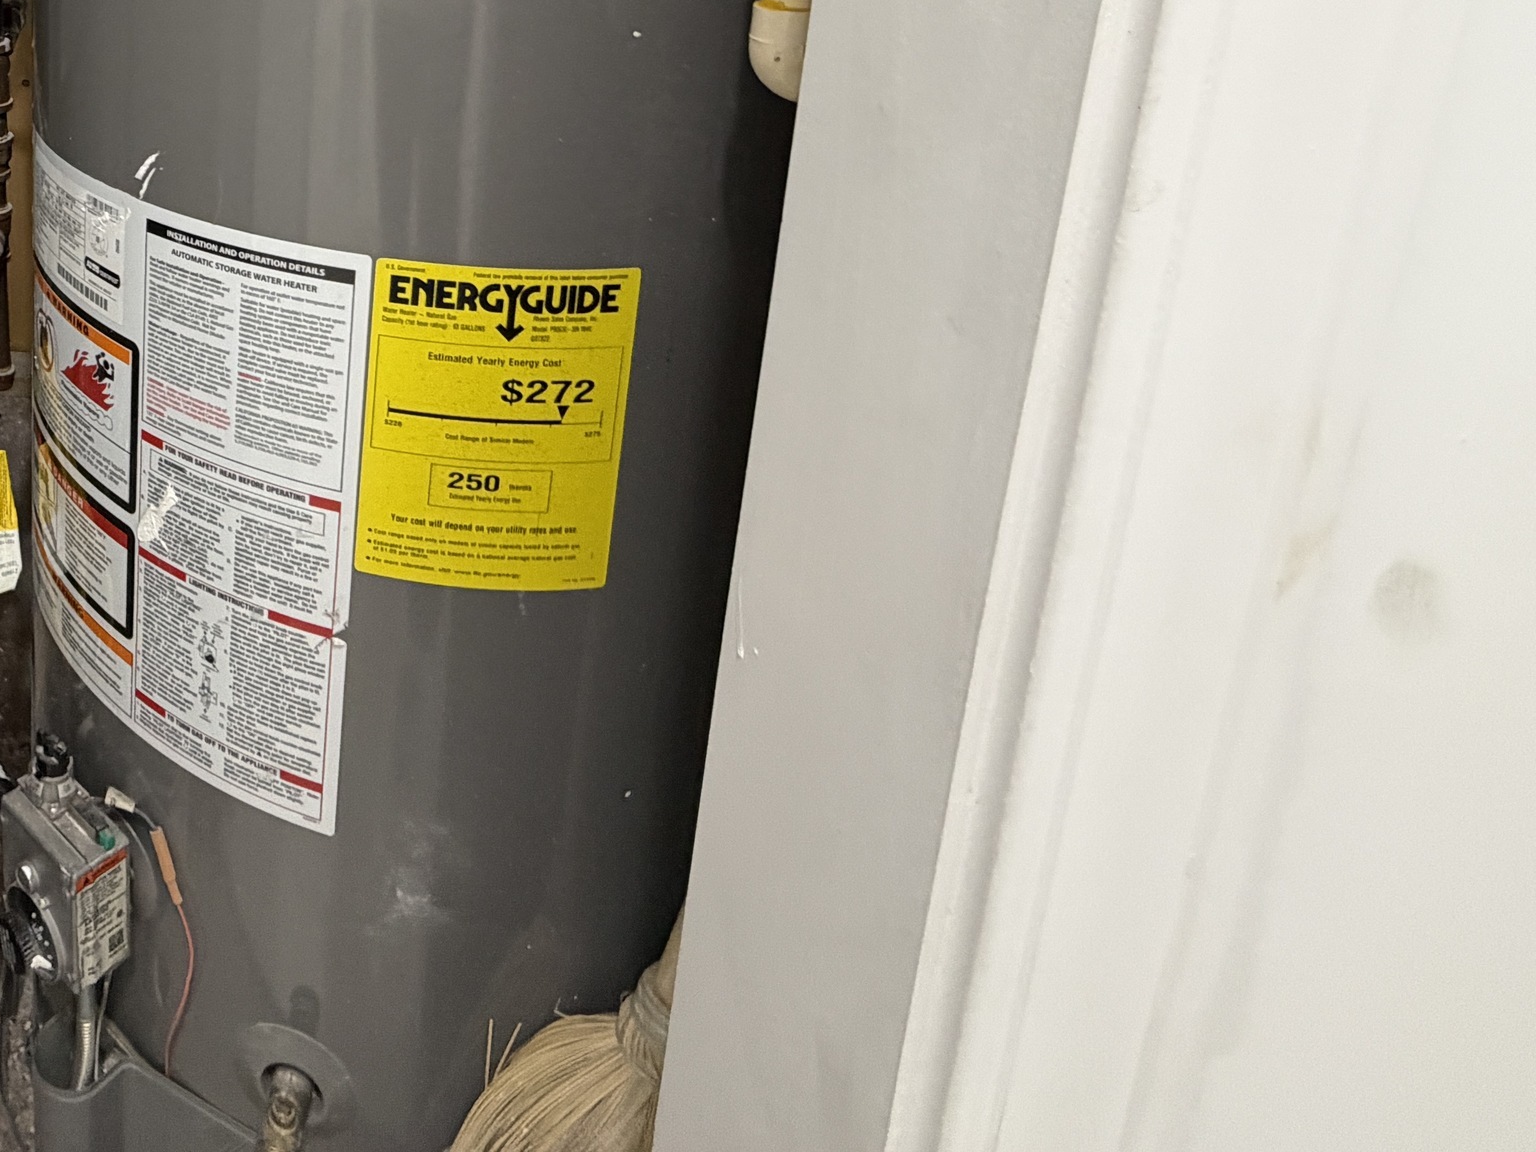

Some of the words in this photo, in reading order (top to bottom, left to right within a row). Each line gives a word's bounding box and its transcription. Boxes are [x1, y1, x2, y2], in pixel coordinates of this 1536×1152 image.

[167, 230, 218, 252] INSTALLATION
[219, 246, 237, 257] AND
[239, 251, 287, 269] OPERATION
[288, 262, 325, 276] DETAILS
[172, 249, 213, 268] AUTOMATIC
[215, 262, 252, 278] STORAGE
[253, 272, 282, 285] WATER
[284, 279, 317, 293] HEATER
[389, 274, 621, 314] ENERGYGUIDE
[428, 352, 473, 364] Estimated
[477, 357, 505, 367] Yearly
[509, 359, 539, 368] Energy
[501, 379, 595, 406] $272
[165, 445, 176, 456] FOR
[178, 451, 193, 462] YOUR
[195, 458, 218, 473] SAFETY
[219, 468, 236, 480] READ
[238, 475, 264, 490] BEFORE
[266, 485, 306, 502] OPERATING
[447, 472, 500, 492] 250
[391, 513, 408, 523] Your
[411, 517, 426, 526] cost
[429, 519, 442, 527] will
[445, 522, 472, 532] depend
[487, 526, 503, 534] your
[506, 527, 526, 535] utility
[549, 526, 562, 534] and
[189, 577, 216, 596] LIGHTING
[167, 713, 174, 722] TO
[192, 729, 203, 740] GAS
[205, 737, 216, 747] OFF
[218, 743, 225, 752] TO
[227, 748, 239, 759] THE
[241, 755, 277, 775] APPLIANCE
